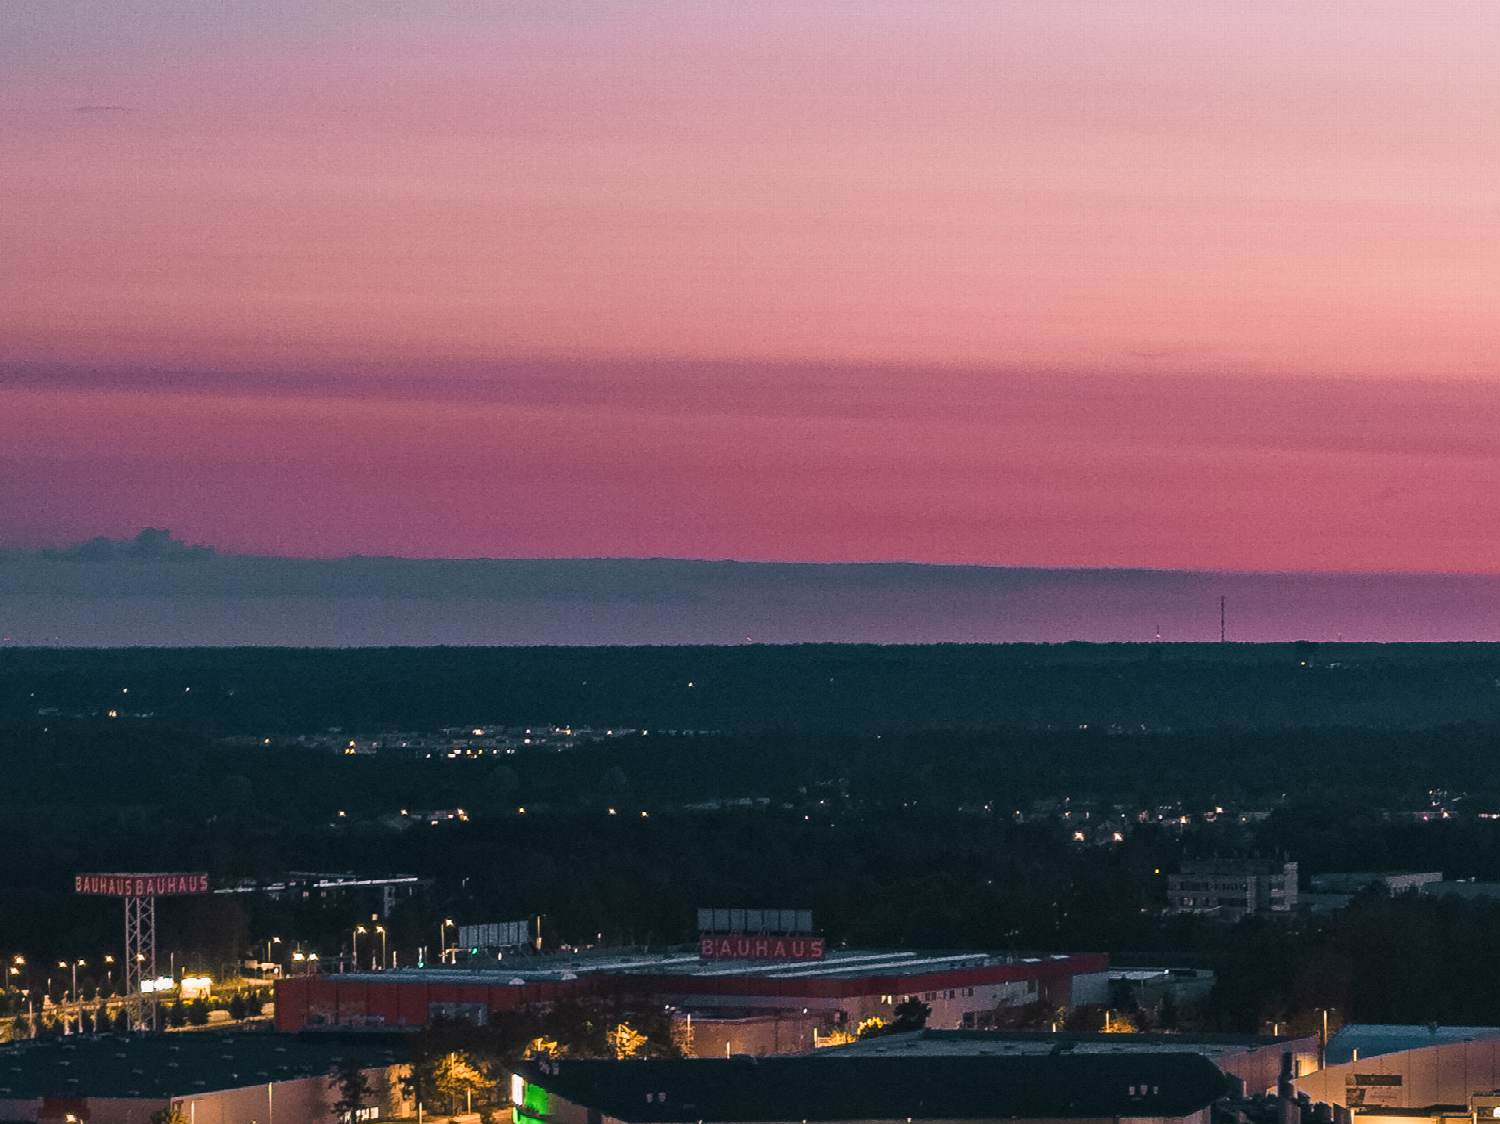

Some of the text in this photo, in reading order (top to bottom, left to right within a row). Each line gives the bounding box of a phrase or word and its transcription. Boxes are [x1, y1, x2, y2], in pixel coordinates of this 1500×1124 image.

[75, 876, 132, 896] BAUHAUS
[135, 876, 208, 896] BAUHAUS
[702, 939, 823, 957] BAUHAUS
